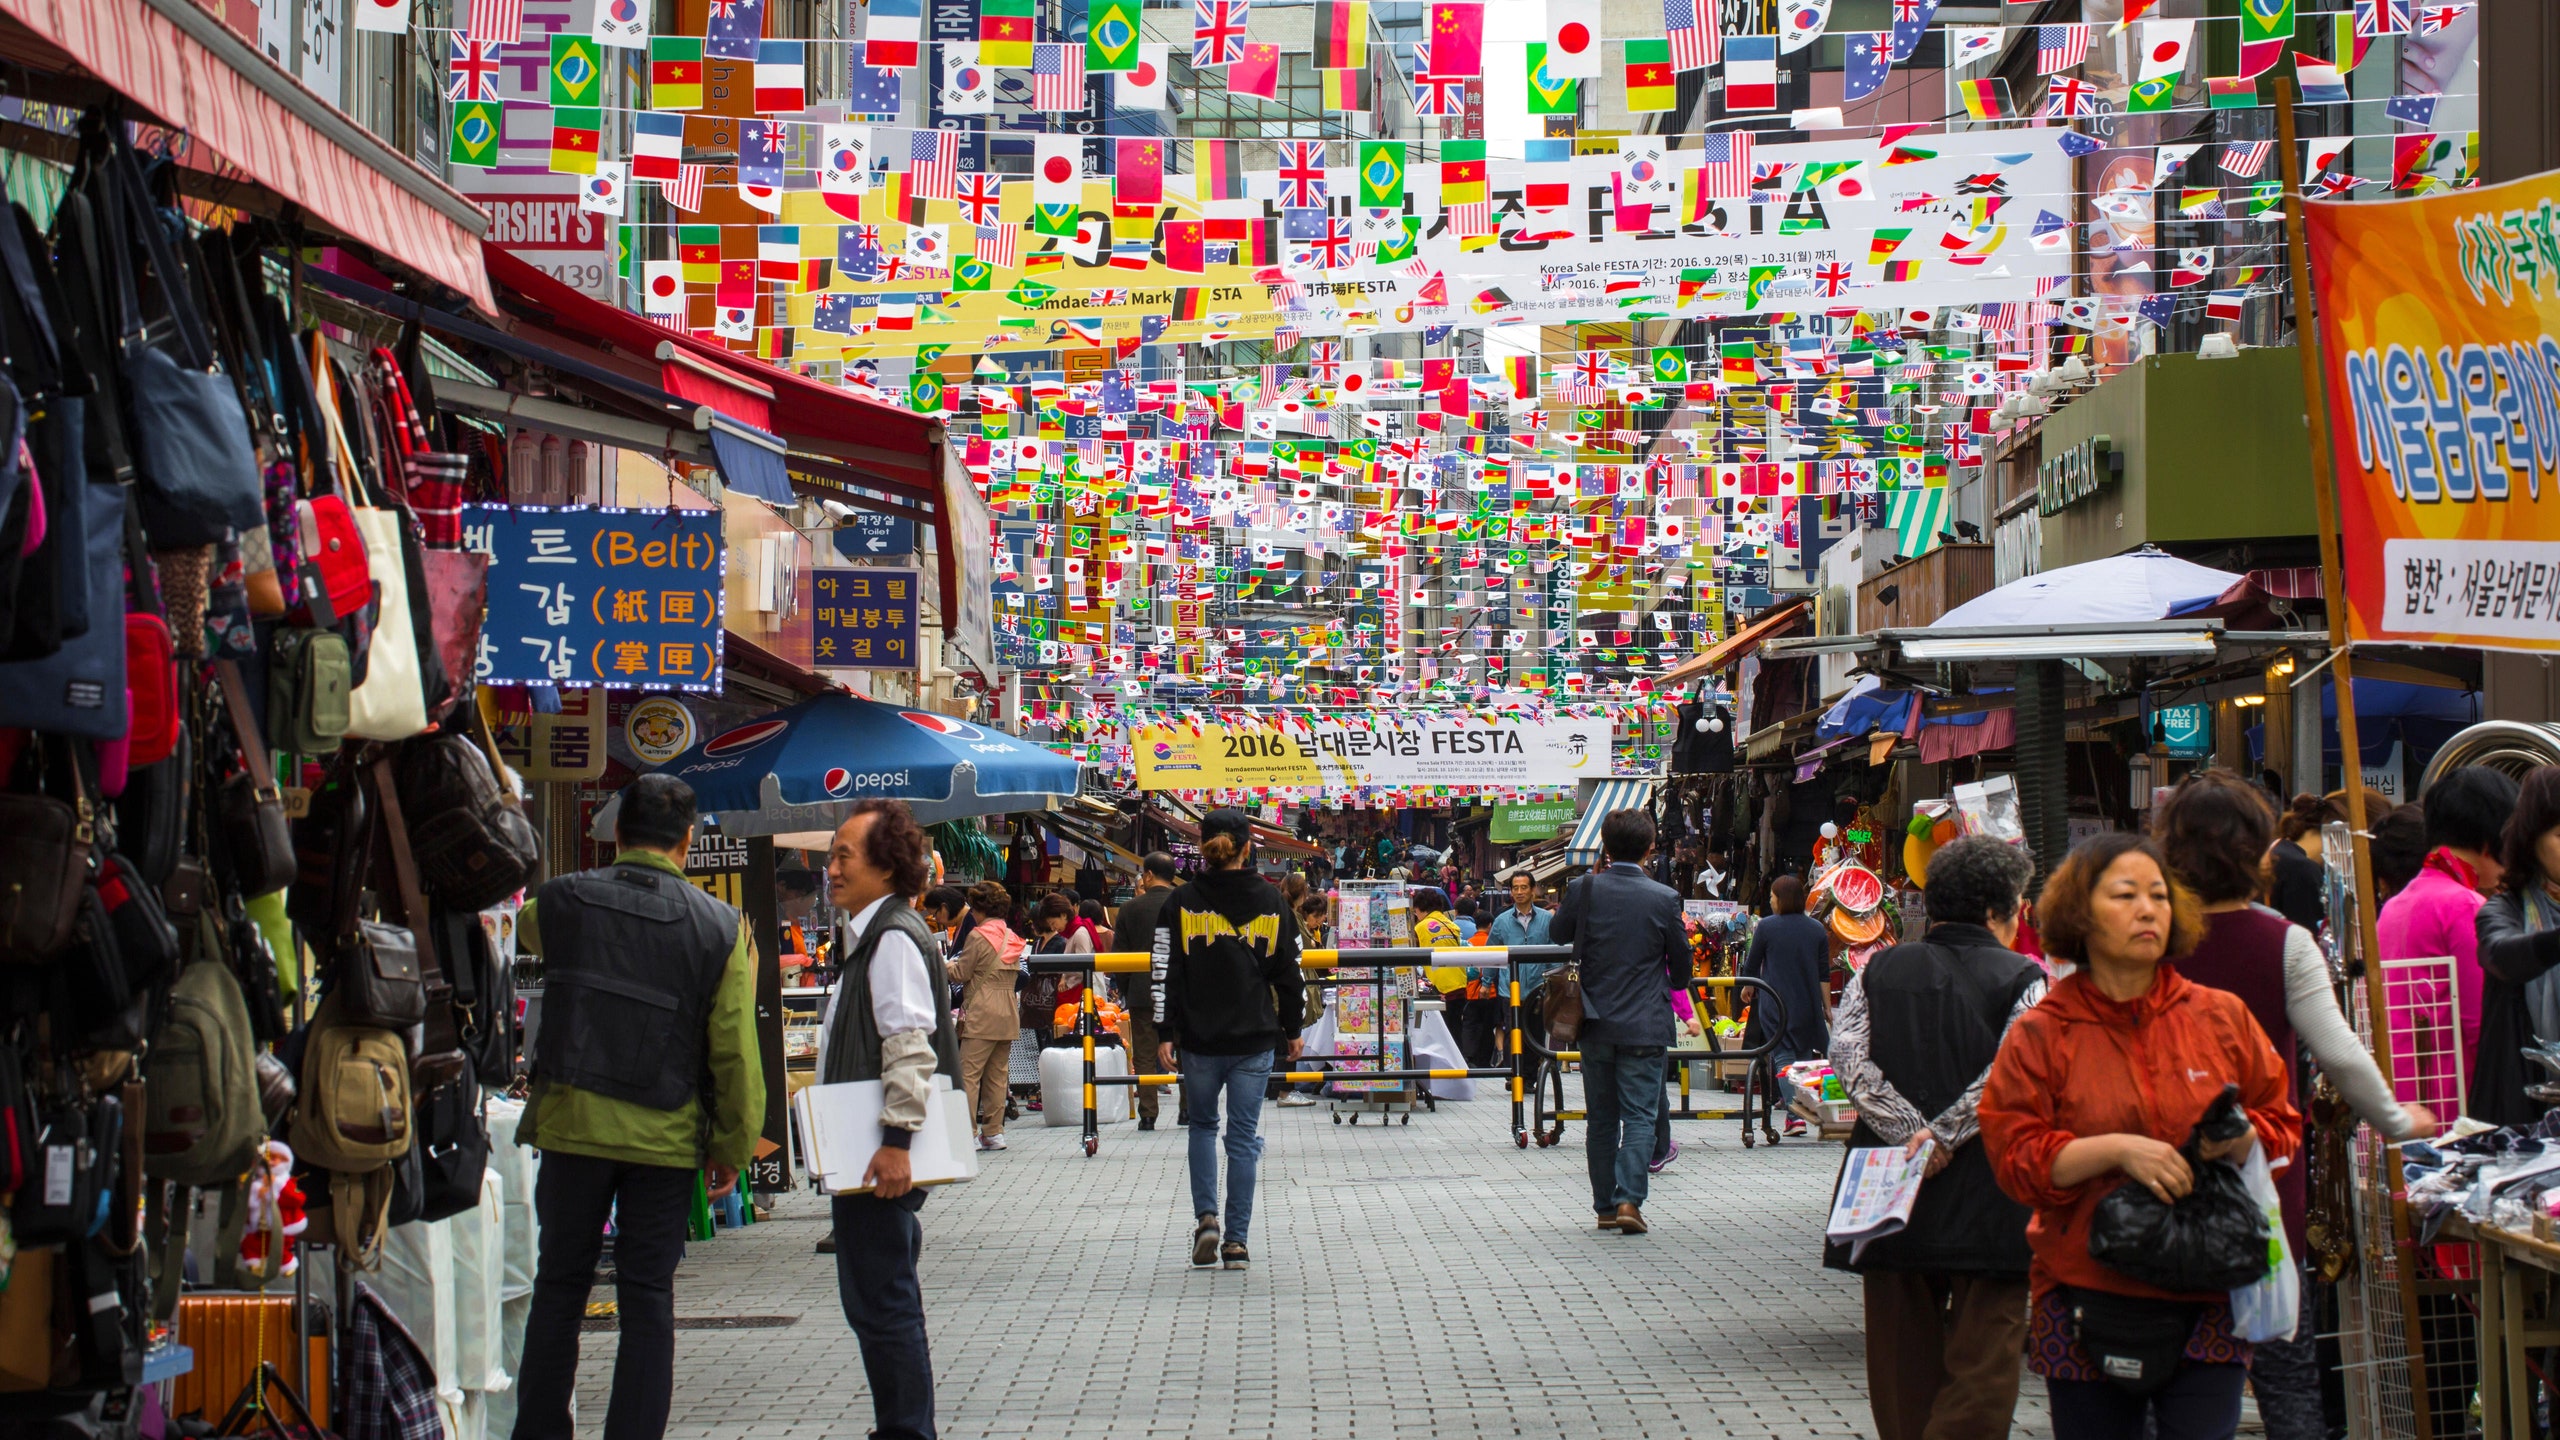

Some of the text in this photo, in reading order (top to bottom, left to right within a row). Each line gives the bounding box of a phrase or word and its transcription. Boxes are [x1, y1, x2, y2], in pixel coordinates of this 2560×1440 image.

[1540, 264, 1573, 274] Korea
[1577, 261, 1600, 272] Sale
[1604, 260, 1639, 270] FESTA
[1642, 259, 1667, 270] 기간:
[1670, 257, 1701, 268] 2016.
[1704, 254, 1749, 267] 9.29(목)
[1761, 251, 1812, 264] 10.31(월)
[1815, 249, 1837, 261] 까지
[857, 514, 895, 527] 화장실
[862, 527, 890, 536] Toilet
[591, 528, 715, 571] (Belt)
[2404, 557, 2442, 616] 협찬
[2460, 558, 2560, 621] 서울남대문시
[817, 607, 906, 629] 비닐봉투
[2164, 708, 2191, 719] TAX
[2164, 718, 2191, 729] FREE
[969, 740, 1020, 755] pepsi
[1221, 730, 1524, 758] 2016 남대문시장 FESTA
[679, 756, 745, 778] pepsi
[1225, 765, 1265, 773] Namdaemun
[855, 769, 911, 791] pepsi
[1547, 808, 1575, 821] NATURE
[1847, 829, 1873, 843] SALE!
[1151, 927, 1171, 1023] WORLD TOUR
